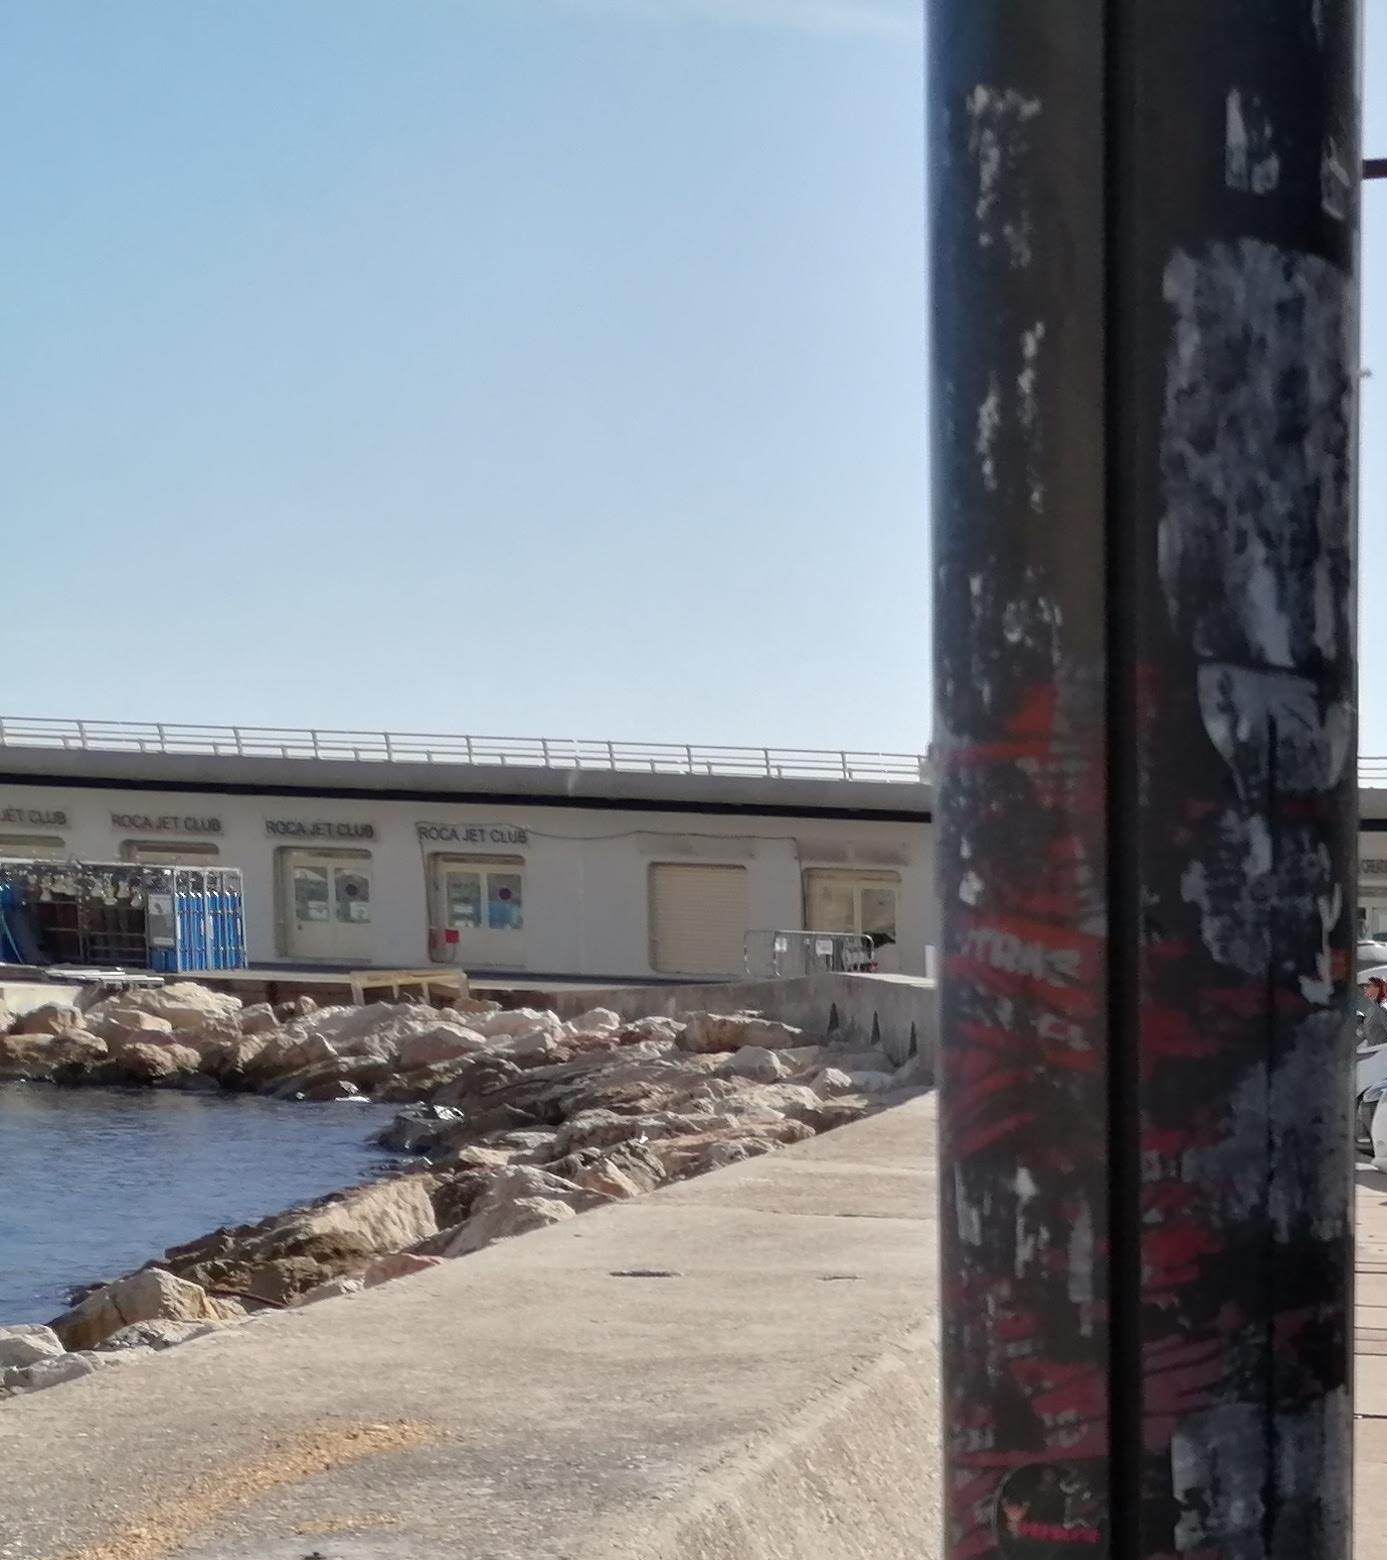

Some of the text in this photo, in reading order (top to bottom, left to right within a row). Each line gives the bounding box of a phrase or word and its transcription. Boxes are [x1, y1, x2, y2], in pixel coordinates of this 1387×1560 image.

[28, 810, 66, 825] CLUB
[112, 814, 222, 832] ROCA JET CLUB
[265, 820, 374, 838] ROCA JET CLUB
[418, 826, 528, 844] ROCA JET CLUB
